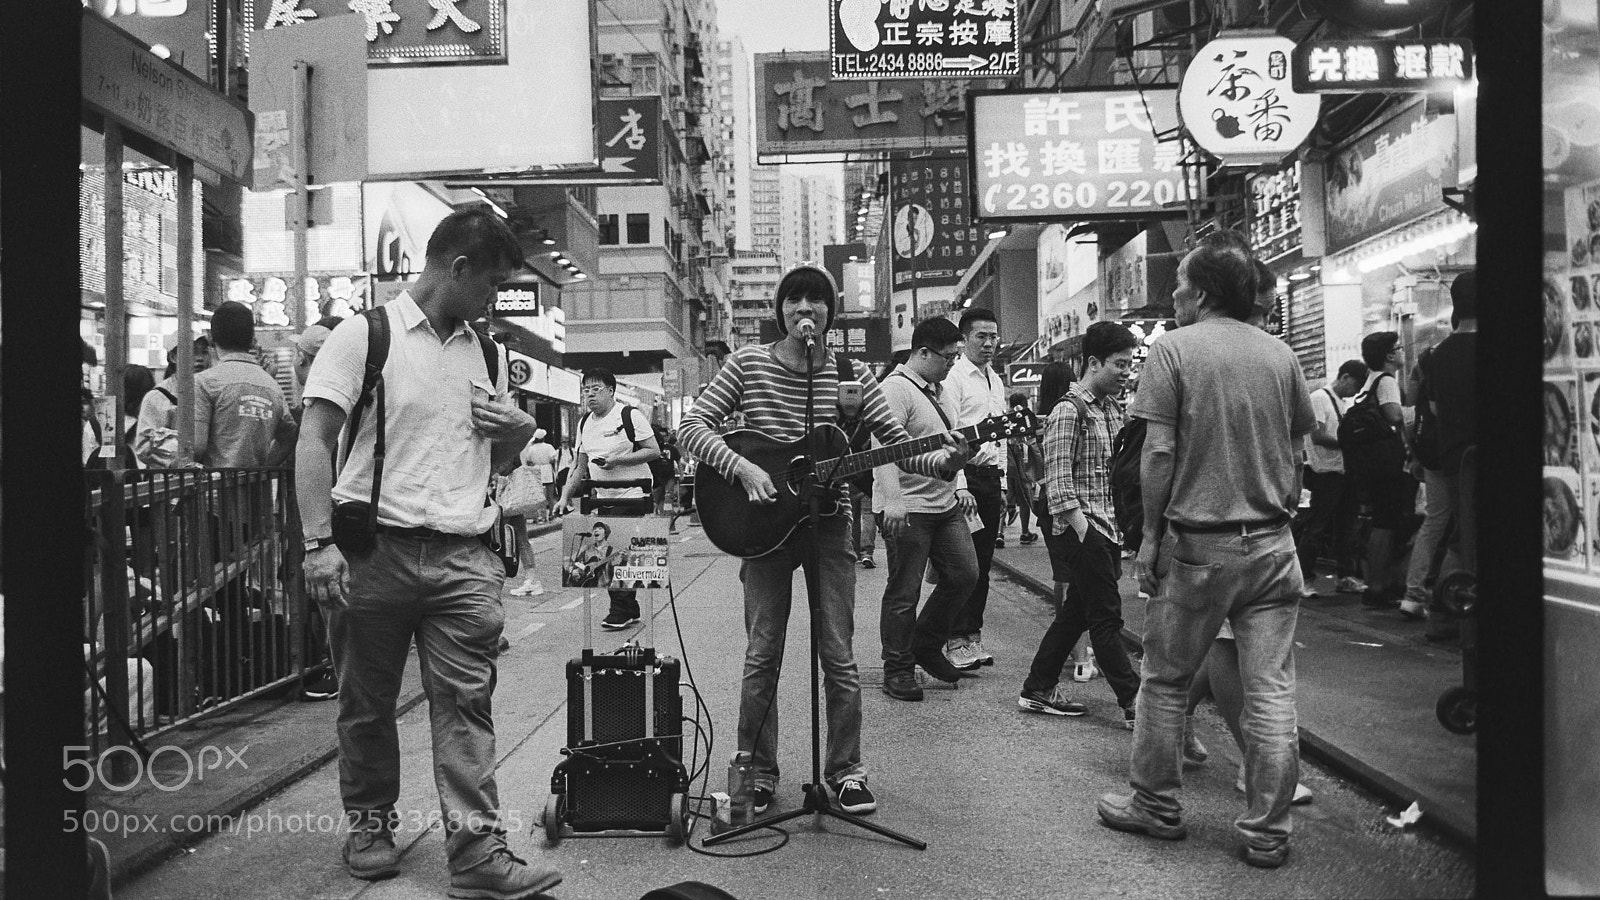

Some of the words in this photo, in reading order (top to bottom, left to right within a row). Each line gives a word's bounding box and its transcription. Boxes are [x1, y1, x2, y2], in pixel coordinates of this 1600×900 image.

[881, 20, 1013, 45] 正宗按摩
[131, 50, 173, 93] Nelson
[836, 53, 904, 72] TEL:2434
[908, 52, 943, 70] 8886
[989, 52, 1015, 70] 2/F
[605, 108, 646, 150] 店
[1006, 181, 1097, 211] 2360
[630, 537, 656, 547] OLIVER
